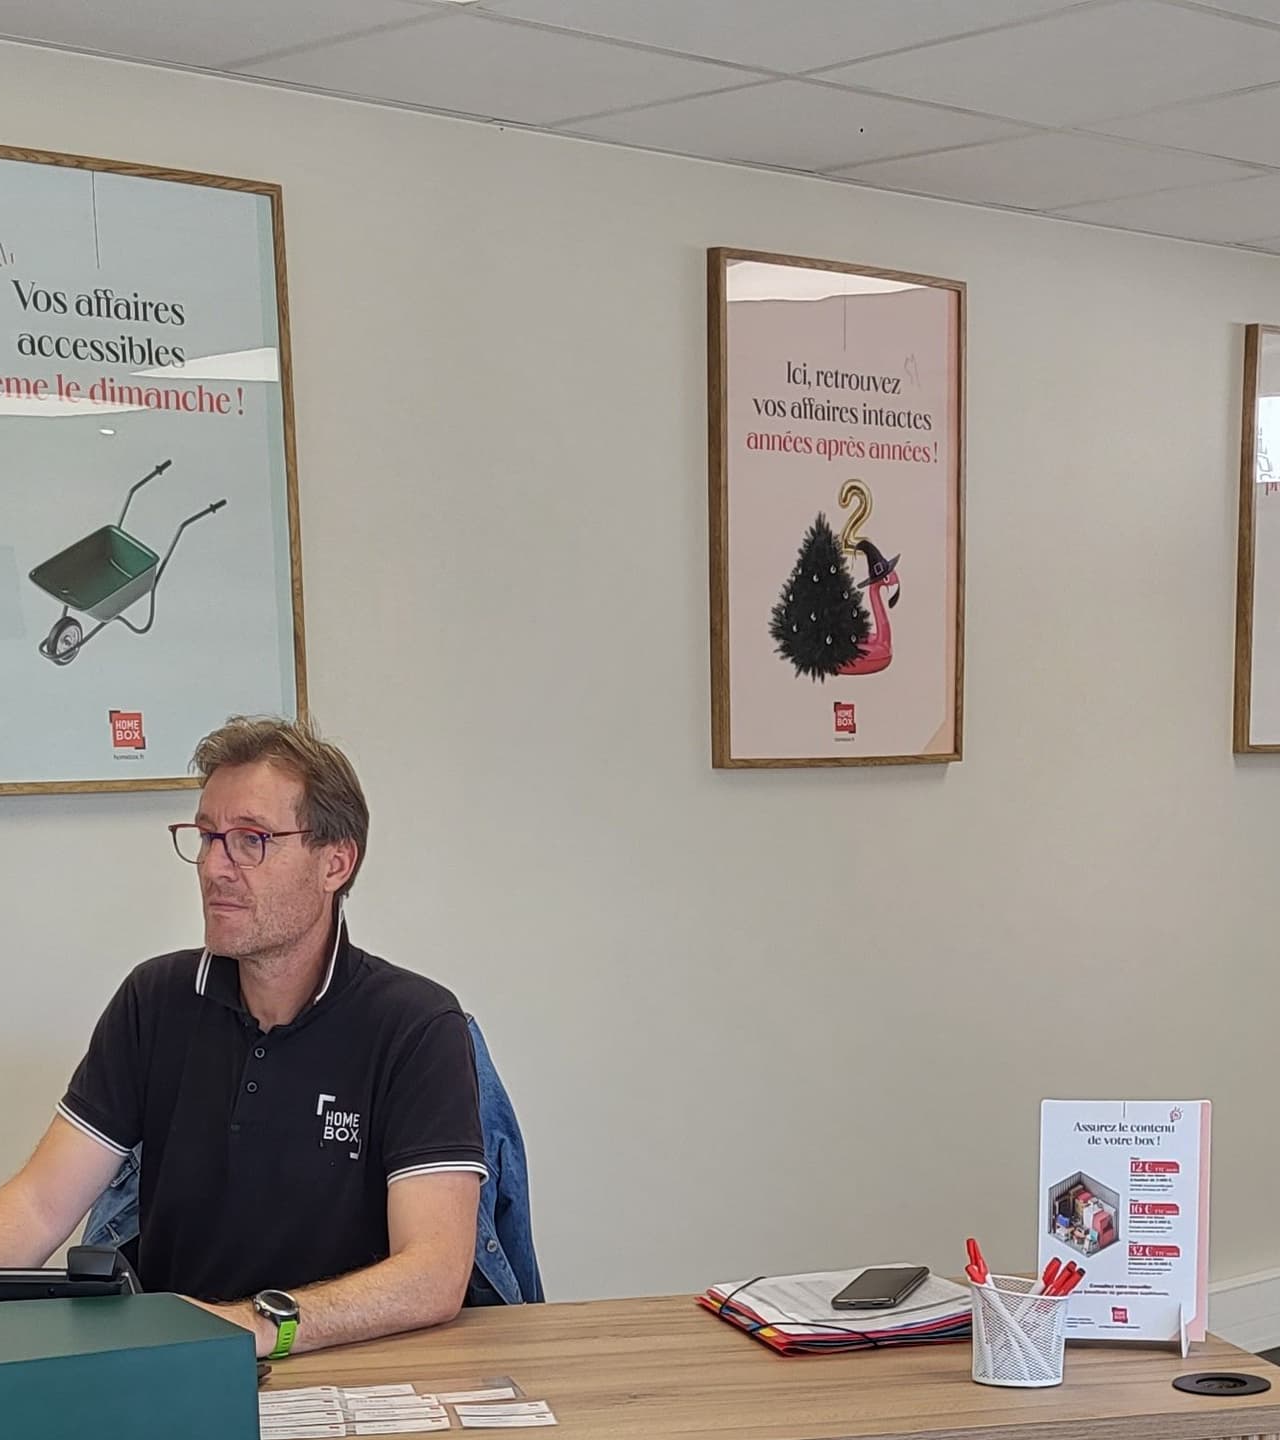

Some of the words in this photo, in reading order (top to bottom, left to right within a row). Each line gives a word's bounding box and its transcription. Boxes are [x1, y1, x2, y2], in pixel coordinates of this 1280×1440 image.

[11, 279, 68, 315] Vos
[75, 288, 185, 326] affaires
[17, 332, 185, 369] accessibles
[786, 361, 812, 390] Ici,
[816, 368, 901, 395] retrouvez
[56, 374, 81, 403] le
[89, 377, 231, 414] dimanche
[753, 398, 787, 418] vos
[791, 397, 859, 425] affaires
[863, 402, 932, 430] intactes
[746, 430, 813, 455] années
[816, 435, 865, 462] après
[869, 440, 931, 464] années
[115, 719, 141, 730] HOME
[116, 730, 141, 741] BOX
[325, 1110, 361, 1128] HOME
[1073, 1121, 1117, 1133] Assurez
[1119, 1121, 1129, 1133] le
[1130, 1123, 1176, 1133] contenu
[323, 1126, 360, 1143] BOX
[1087, 1135, 1102, 1146] de
[1104, 1136, 1133, 1146] votre
